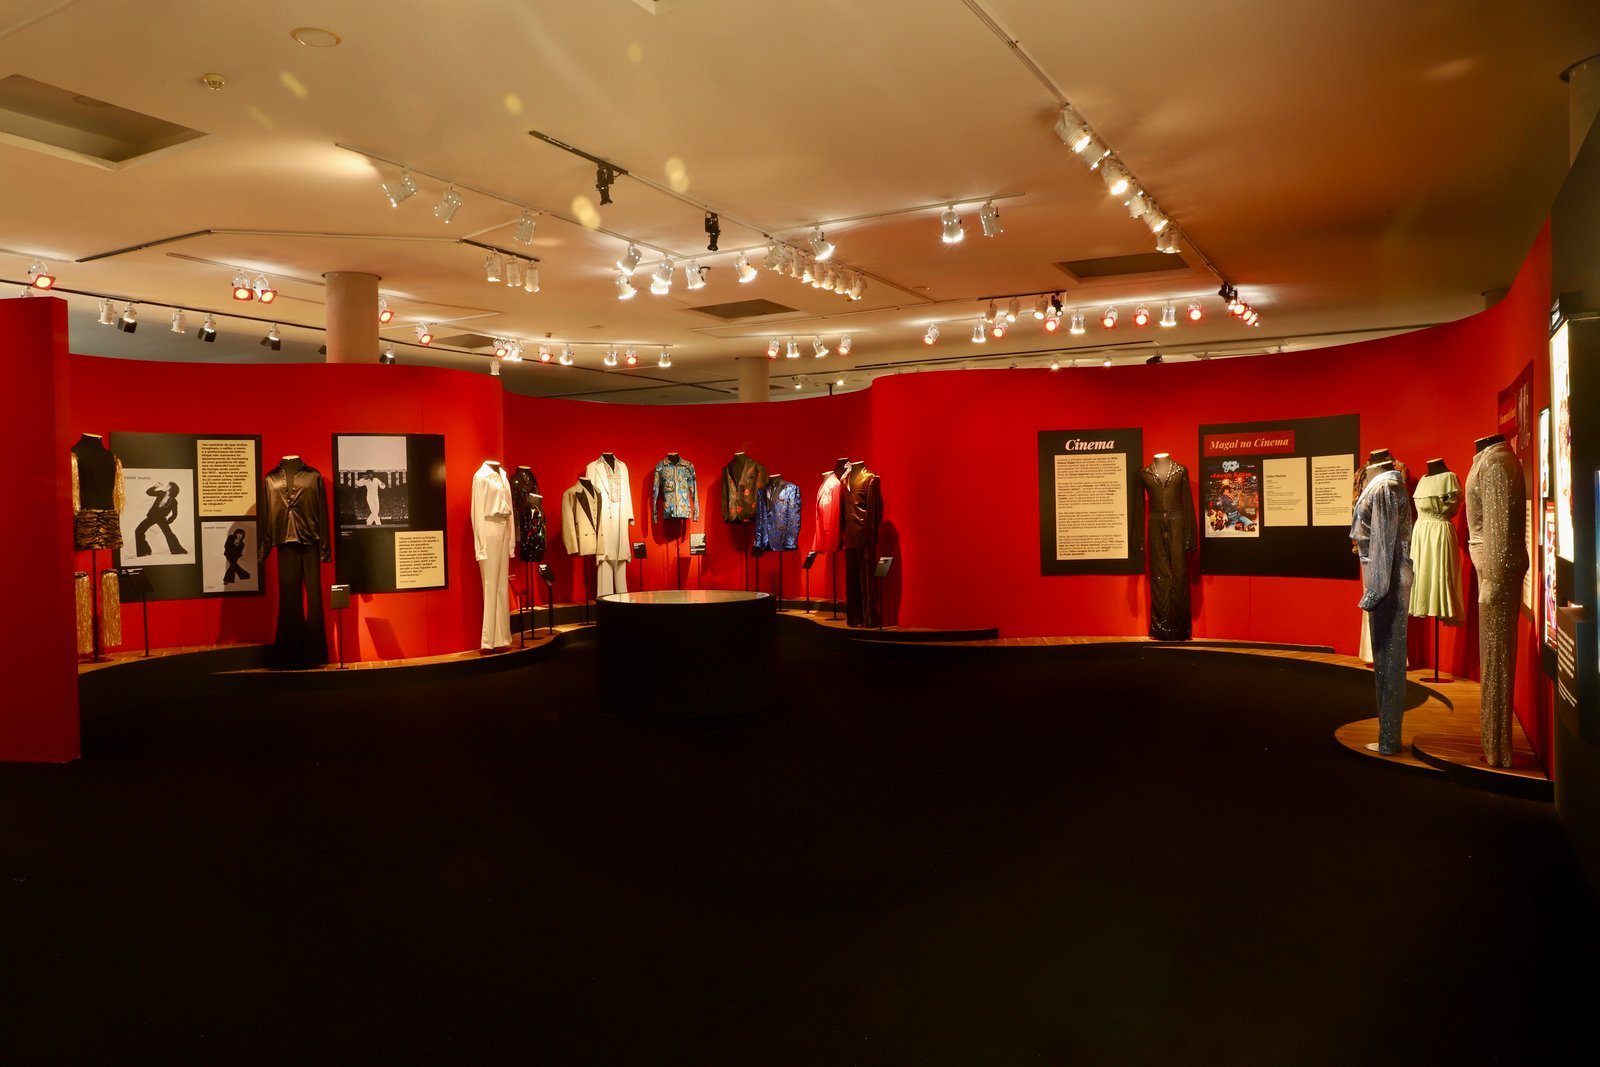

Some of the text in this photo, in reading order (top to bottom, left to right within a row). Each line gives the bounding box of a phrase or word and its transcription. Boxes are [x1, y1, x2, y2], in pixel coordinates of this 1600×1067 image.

[1065, 438, 1114, 450] Cinema
[1209, 440, 1238, 450] Magal
[1254, 438, 1289, 448] Cinema
